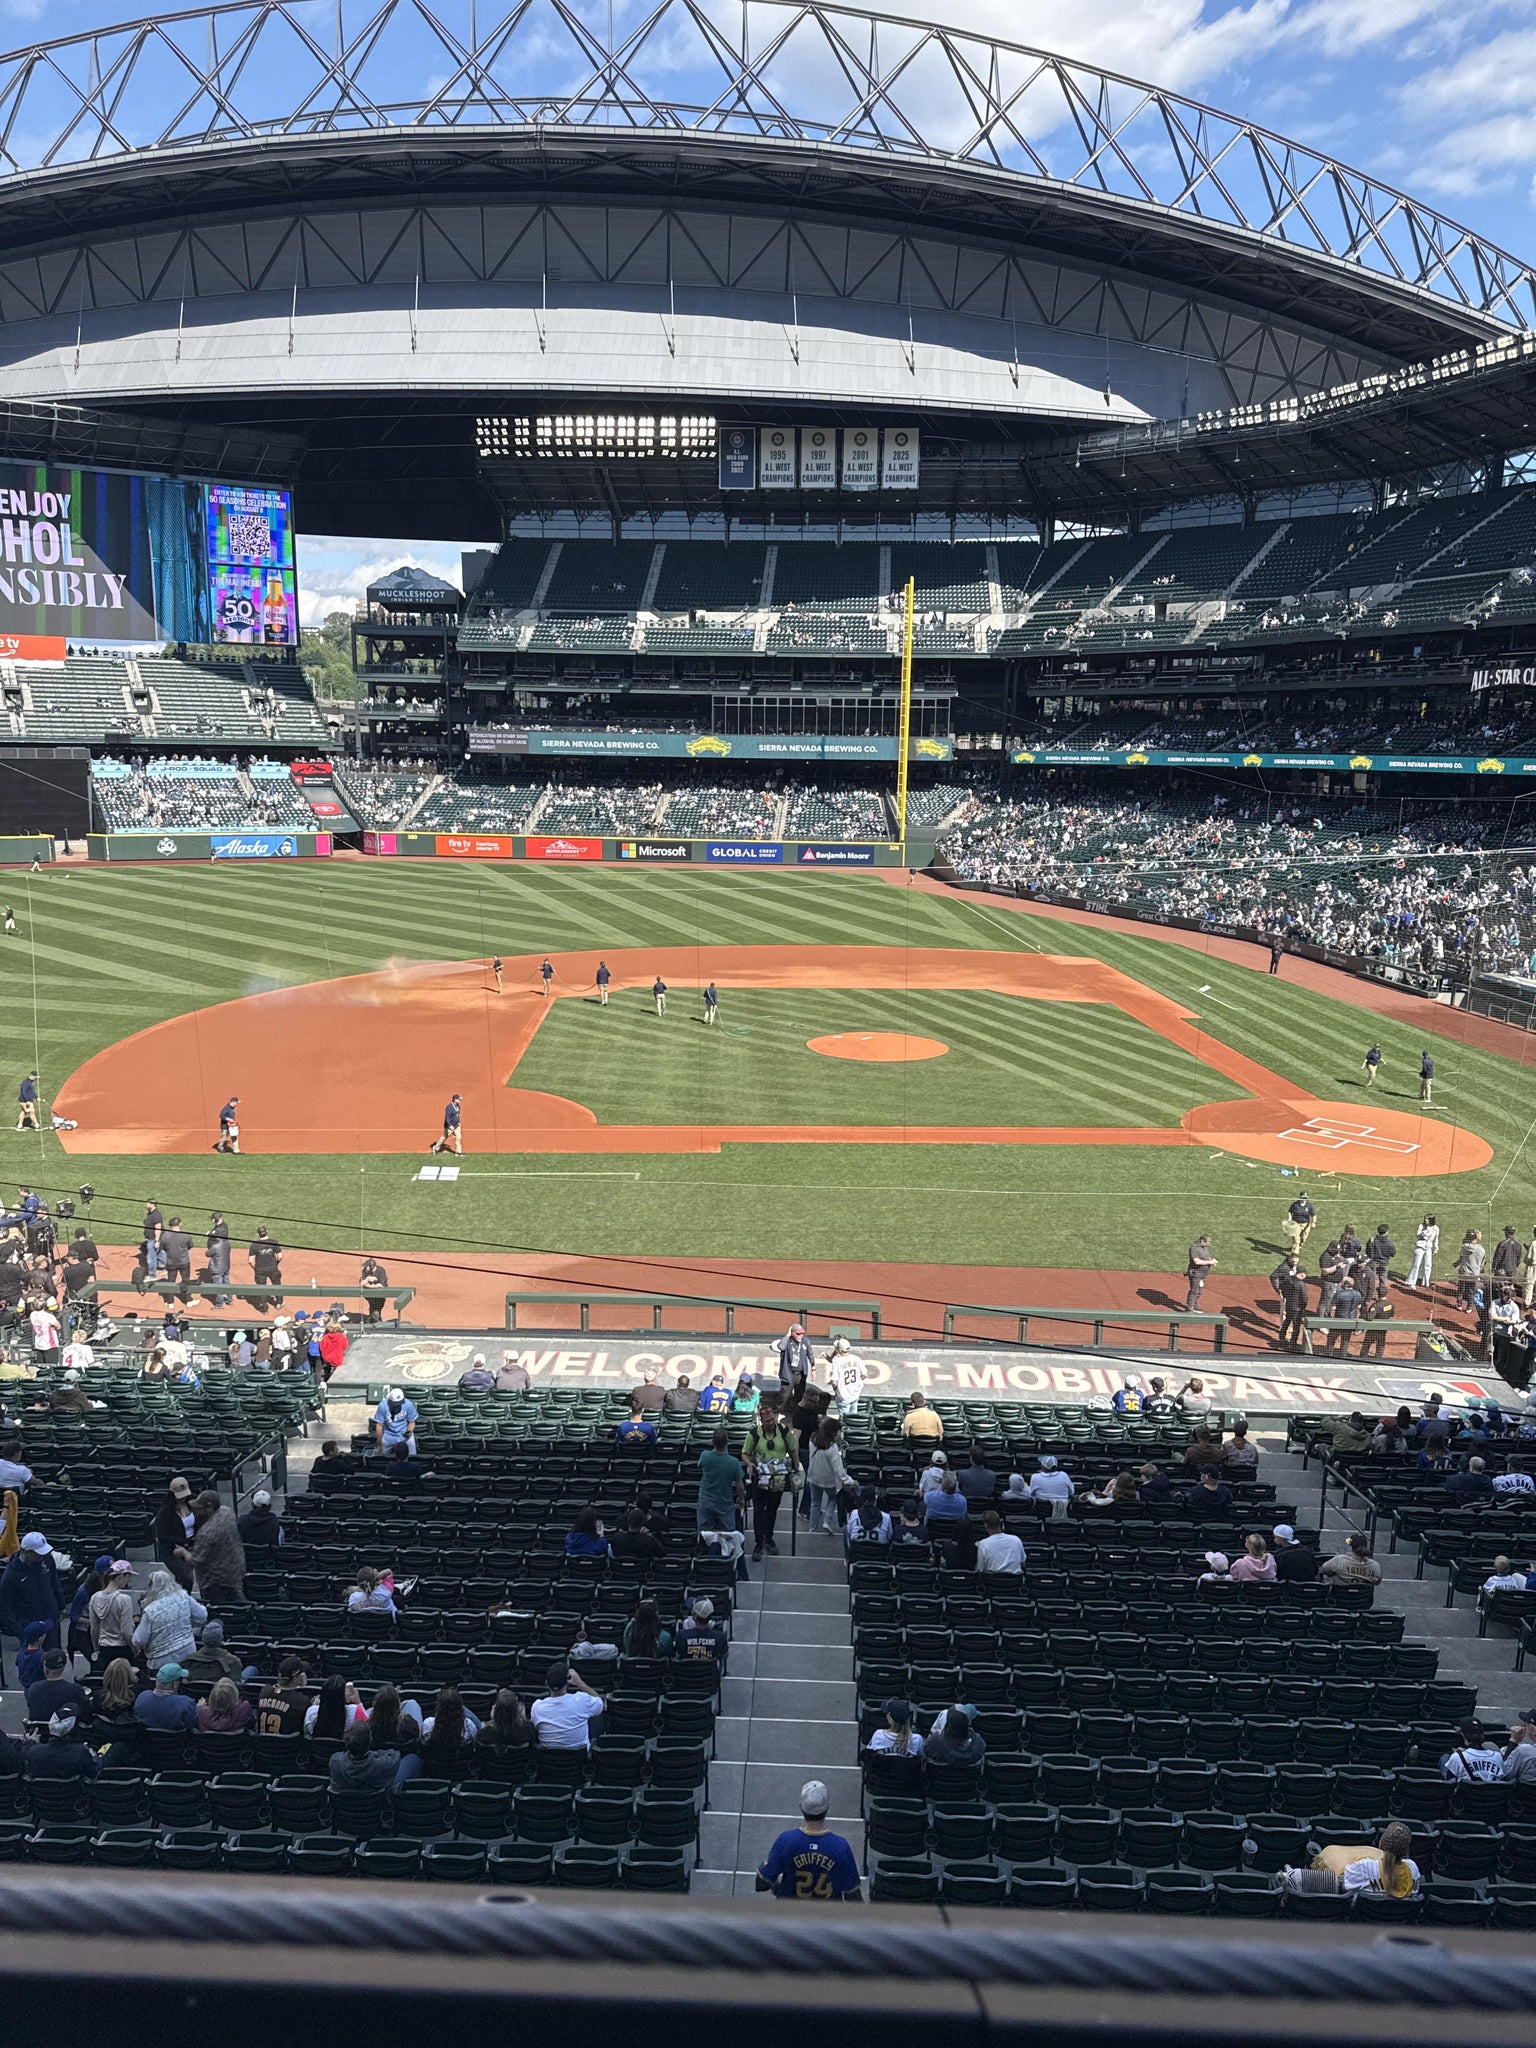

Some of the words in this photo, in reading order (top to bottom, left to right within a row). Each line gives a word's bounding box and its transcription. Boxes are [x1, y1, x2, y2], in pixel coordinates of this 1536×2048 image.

[770, 450, 786, 460] 1995
[811, 450, 826, 460] 1997
[852, 450, 869, 460] 2001
[893, 450, 910, 460] 2025
[765, 463, 775, 471] A.L.
[775, 463, 790, 471] WEST
[805, 463, 815, 471] A.L.
[816, 463, 831, 471] WEST
[847, 463, 857, 471] A.L.
[858, 463, 873, 471] WEST
[888, 463, 898, 471] A.L.
[899, 463, 913, 471] WEST
[0, 488, 72, 519] ENJOY
[210, 495, 218, 503] 50
[219, 496, 246, 506] SEASONS
[247, 500, 286, 509] CELEBRATION
[0, 519, 84, 566] HOL
[0, 567, 126, 609] NSIBLY
[378, 590, 446, 598] MUCKLESHOOT
[225, 600, 252, 618] 50
[7, 638, 20, 648] tv
[215, 838, 269, 854] Alaska
[448, 839, 462, 847] fire
[639, 846, 686, 857] Microsoft
[712, 848, 757, 858] GLOBAL
[816, 852, 847, 860] Benjamin
[1085, 902, 1109, 914] STIHL
[1137, 911, 1154, 920] Great
[1155, 913, 1168, 923] Clips
[1208, 925, 1236, 936] LEXUS
[844, 1369, 857, 1385] 23
[1190, 1372, 1368, 1403] PARK
[1346, 1567, 1367, 1576] TATIS
[259, 1698, 290, 1712] MACHADO
[260, 1712, 281, 1734] 13
[793, 1853, 835, 1871] GRIFFEY
[796, 1870, 834, 1898] 24
